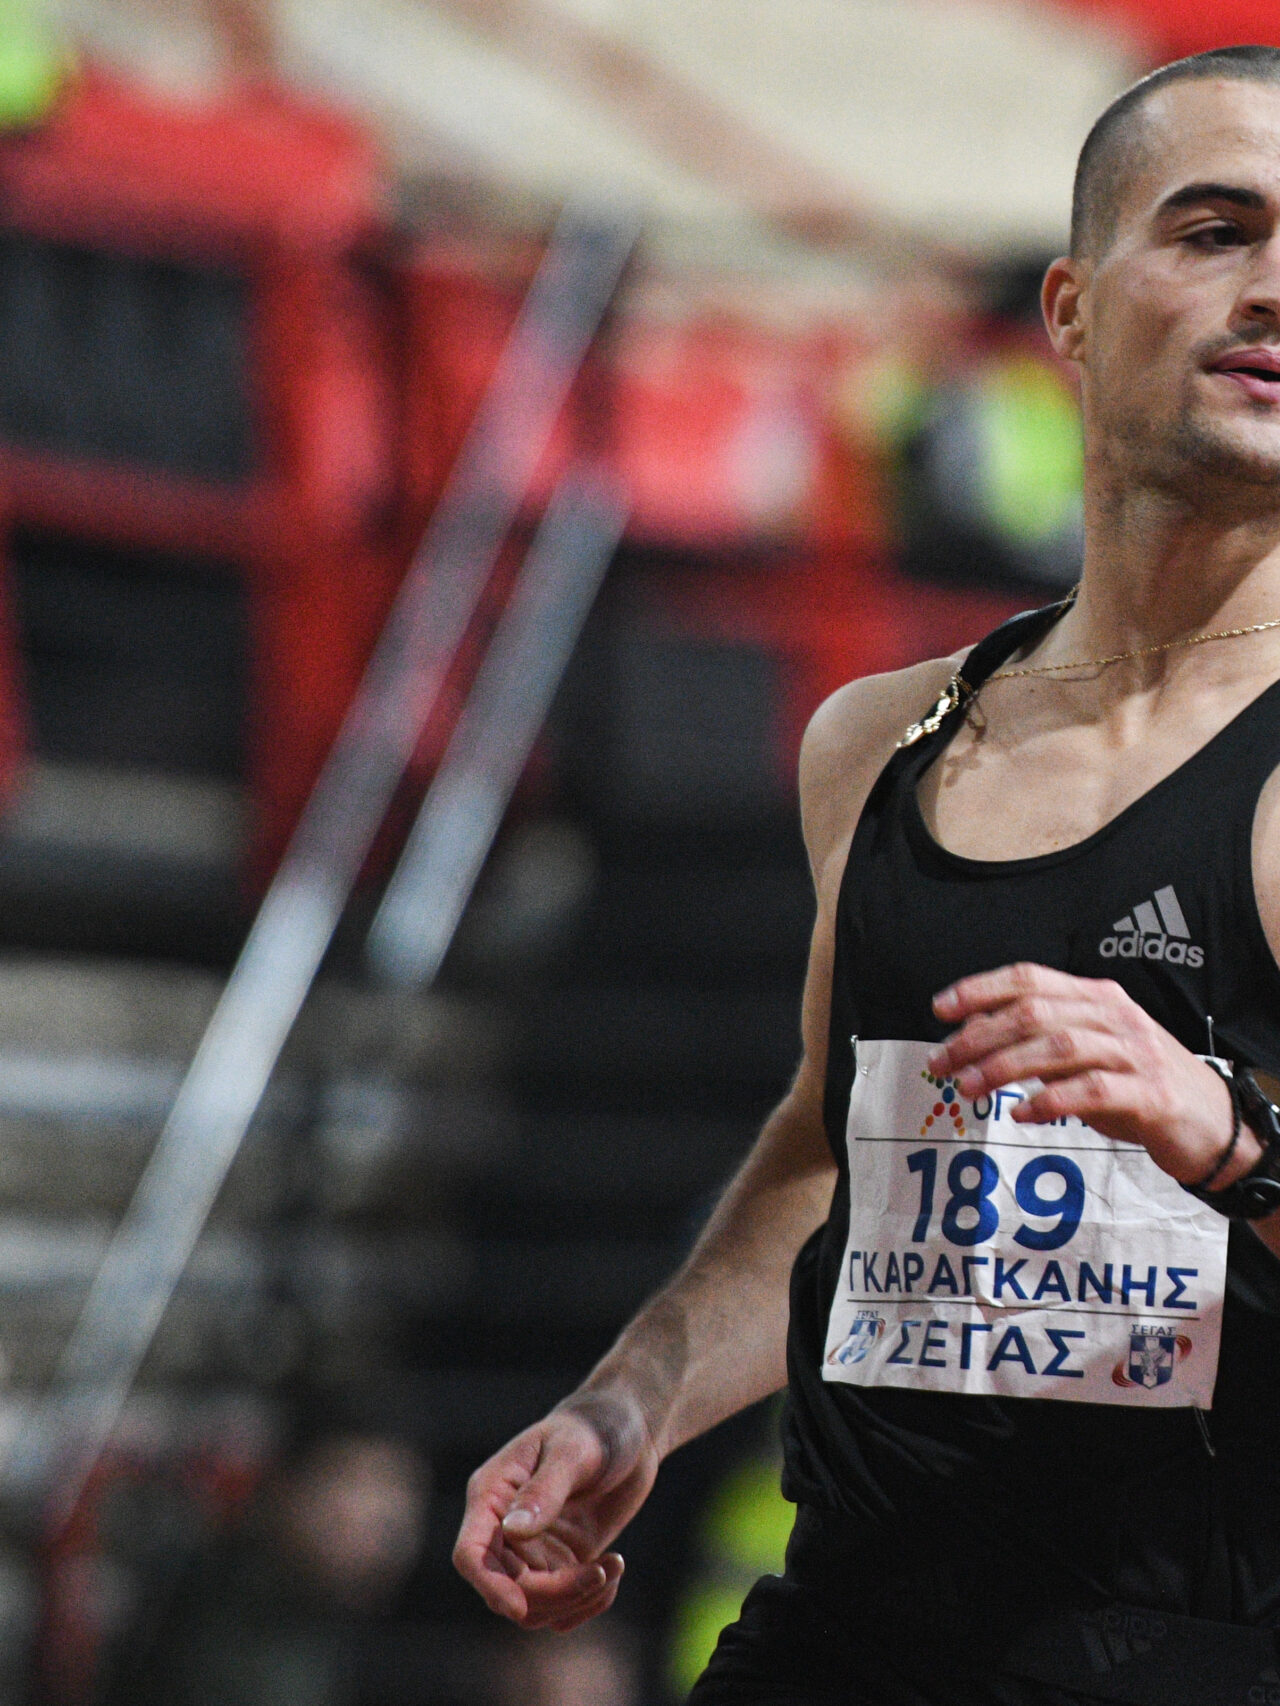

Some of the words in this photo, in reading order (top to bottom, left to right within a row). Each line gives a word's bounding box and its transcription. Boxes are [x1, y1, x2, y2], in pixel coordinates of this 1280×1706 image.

[1099, 929, 1205, 968] adidas
[907, 1148, 1086, 1251] 189
[849, 1250, 1200, 1311] ΓΚΑΡΑΓΚΑΝΗΣ
[886, 1319, 1086, 1378] ΣΕΓΑΣ
[1130, 1323, 1177, 1337] ΣΕΓΑΣ
